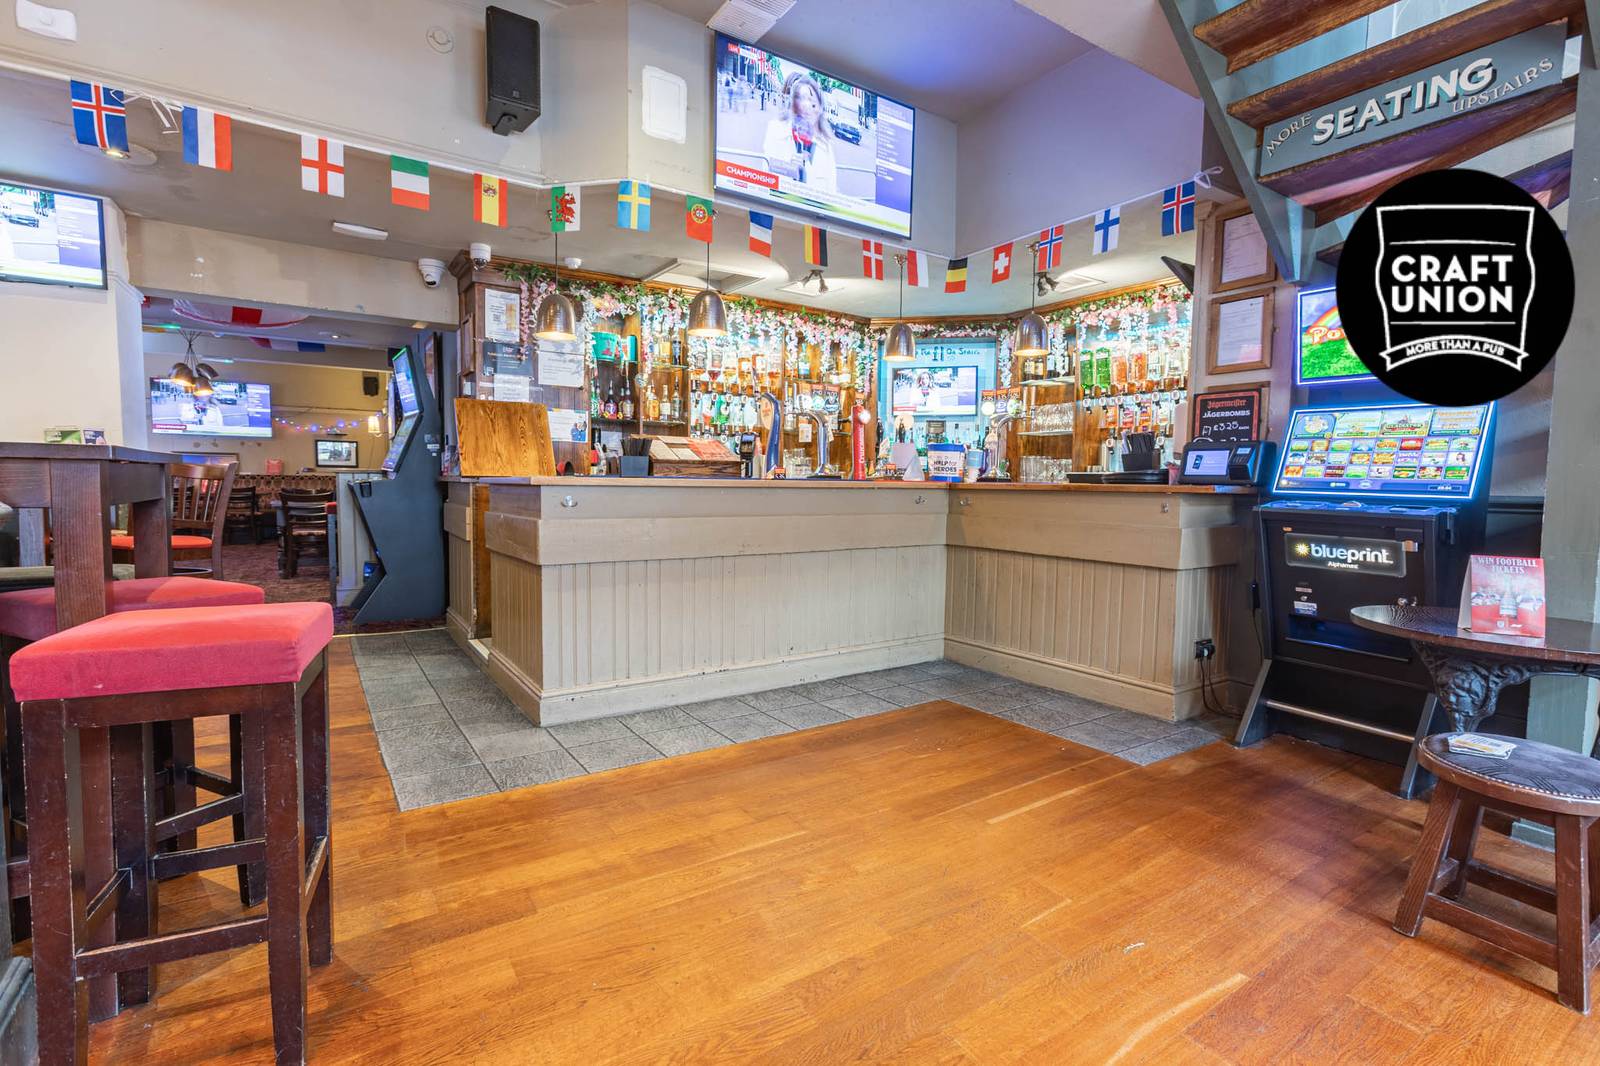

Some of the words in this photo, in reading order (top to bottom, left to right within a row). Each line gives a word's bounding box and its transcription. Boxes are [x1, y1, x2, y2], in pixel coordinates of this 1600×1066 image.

[1450, 57, 1554, 113] UPSTAIRS
[1312, 57, 1494, 144] SEATING
[1265, 113, 1313, 157] MORE
[726, 165, 776, 185] CHAMPIONSHIP
[1310, 543, 1394, 564] blueprint
[1477, 556, 1495, 564] WIN
[1495, 557, 1538, 568] FOOTBALL
[1492, 565, 1525, 574] TICKETS
